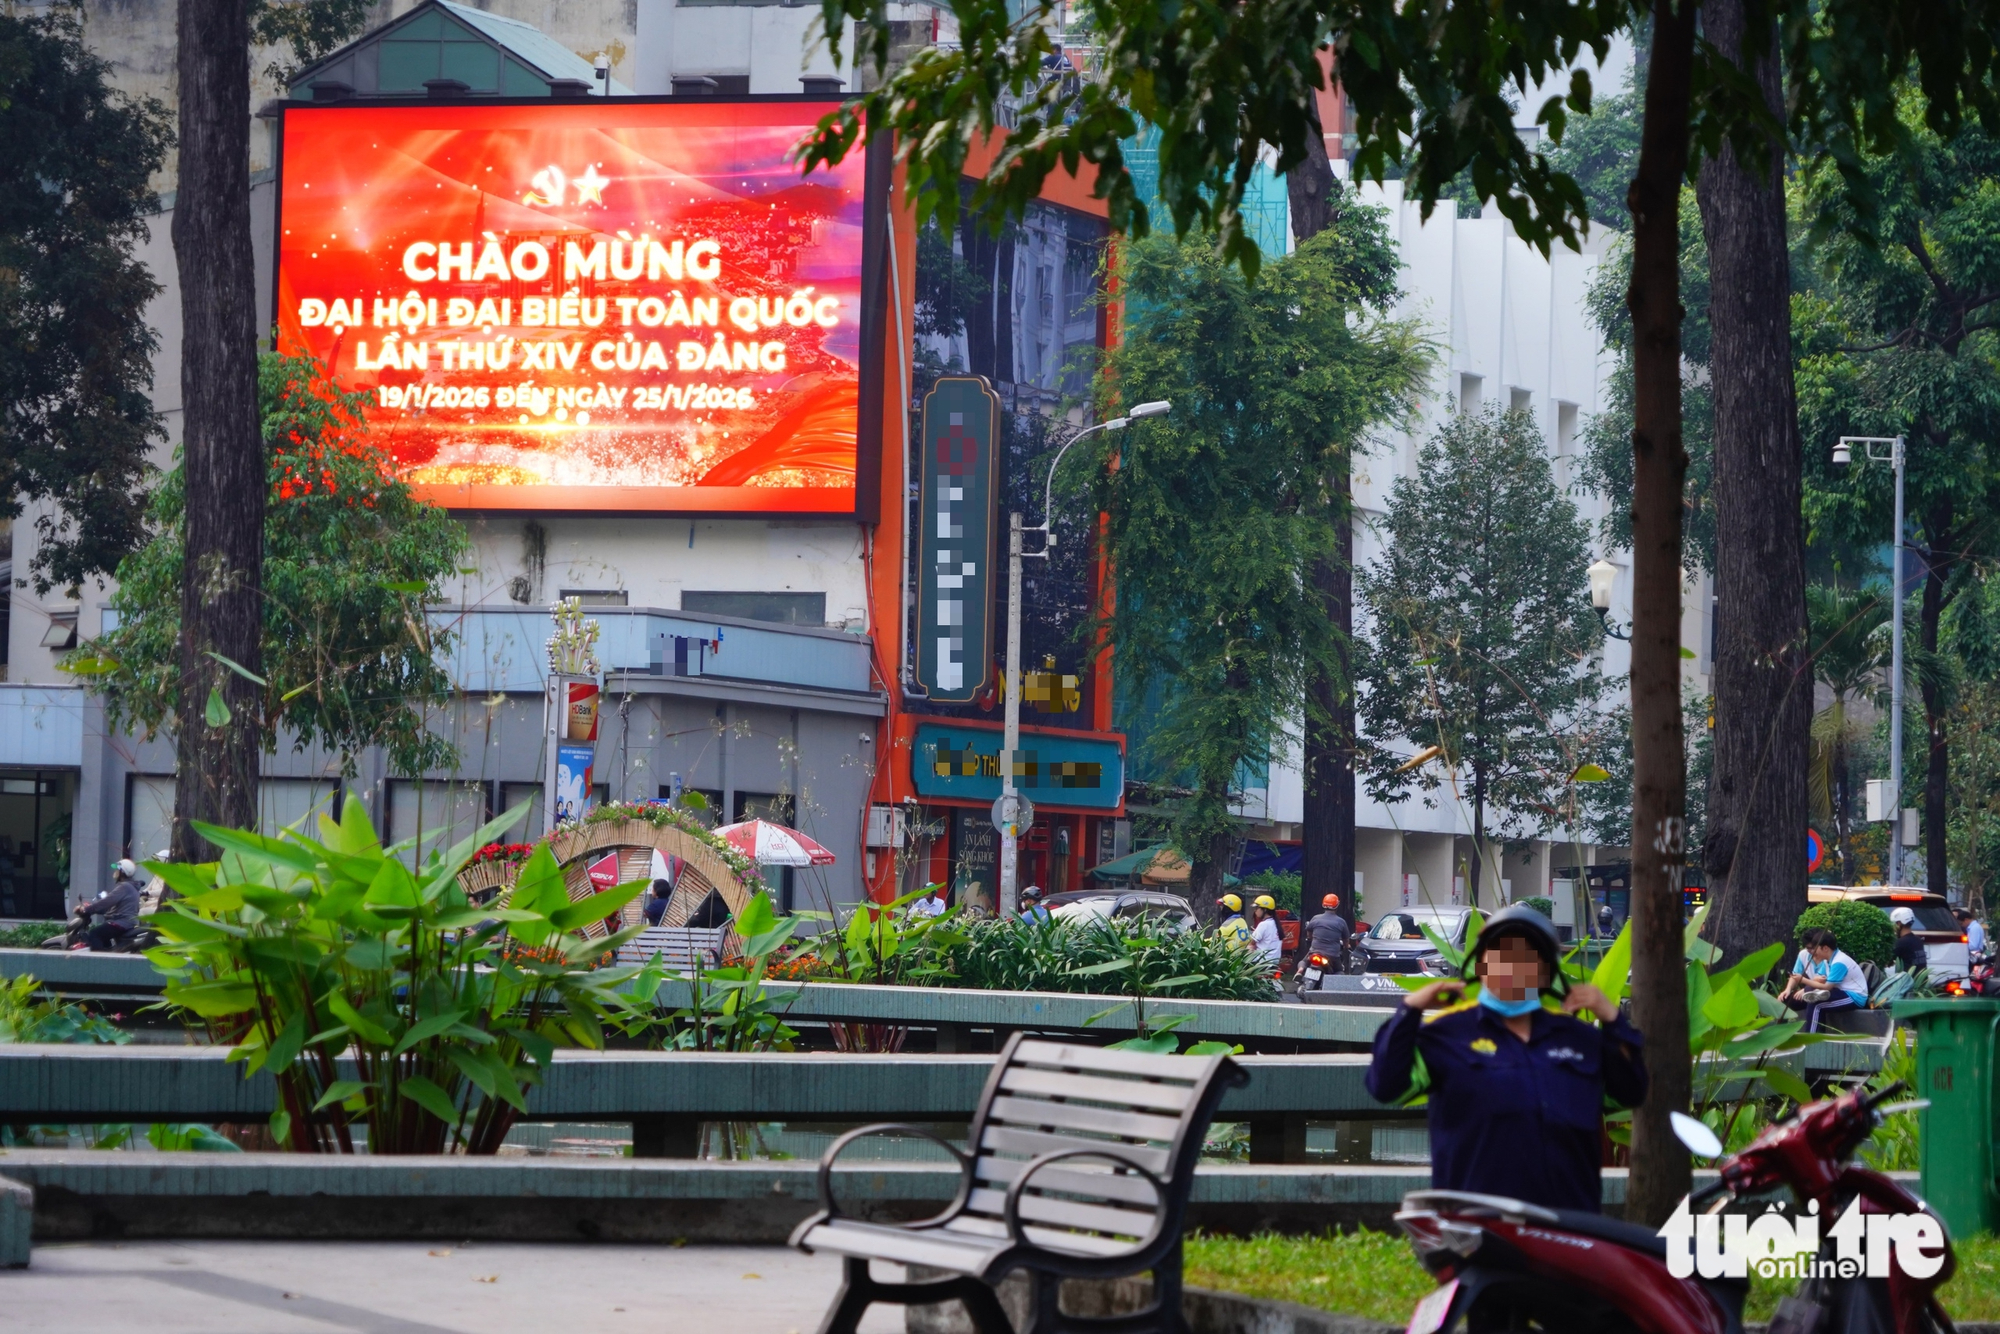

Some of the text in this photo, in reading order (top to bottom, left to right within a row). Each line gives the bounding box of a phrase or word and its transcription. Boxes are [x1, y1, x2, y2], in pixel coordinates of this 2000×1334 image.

[402, 230, 721, 282] CHÀO MỪNG
[298, 286, 840, 335] ĐẠI HỘI ĐẠI BIỂU TOÀN QUỐC
[356, 331, 786, 371] LẦN THỨ XIV CỦA ĐẢNG
[379, 380, 752, 411] 19/1/2026 ĐẾN NGÀY 25/1/2026
[571, 704, 592, 715] HDBank
